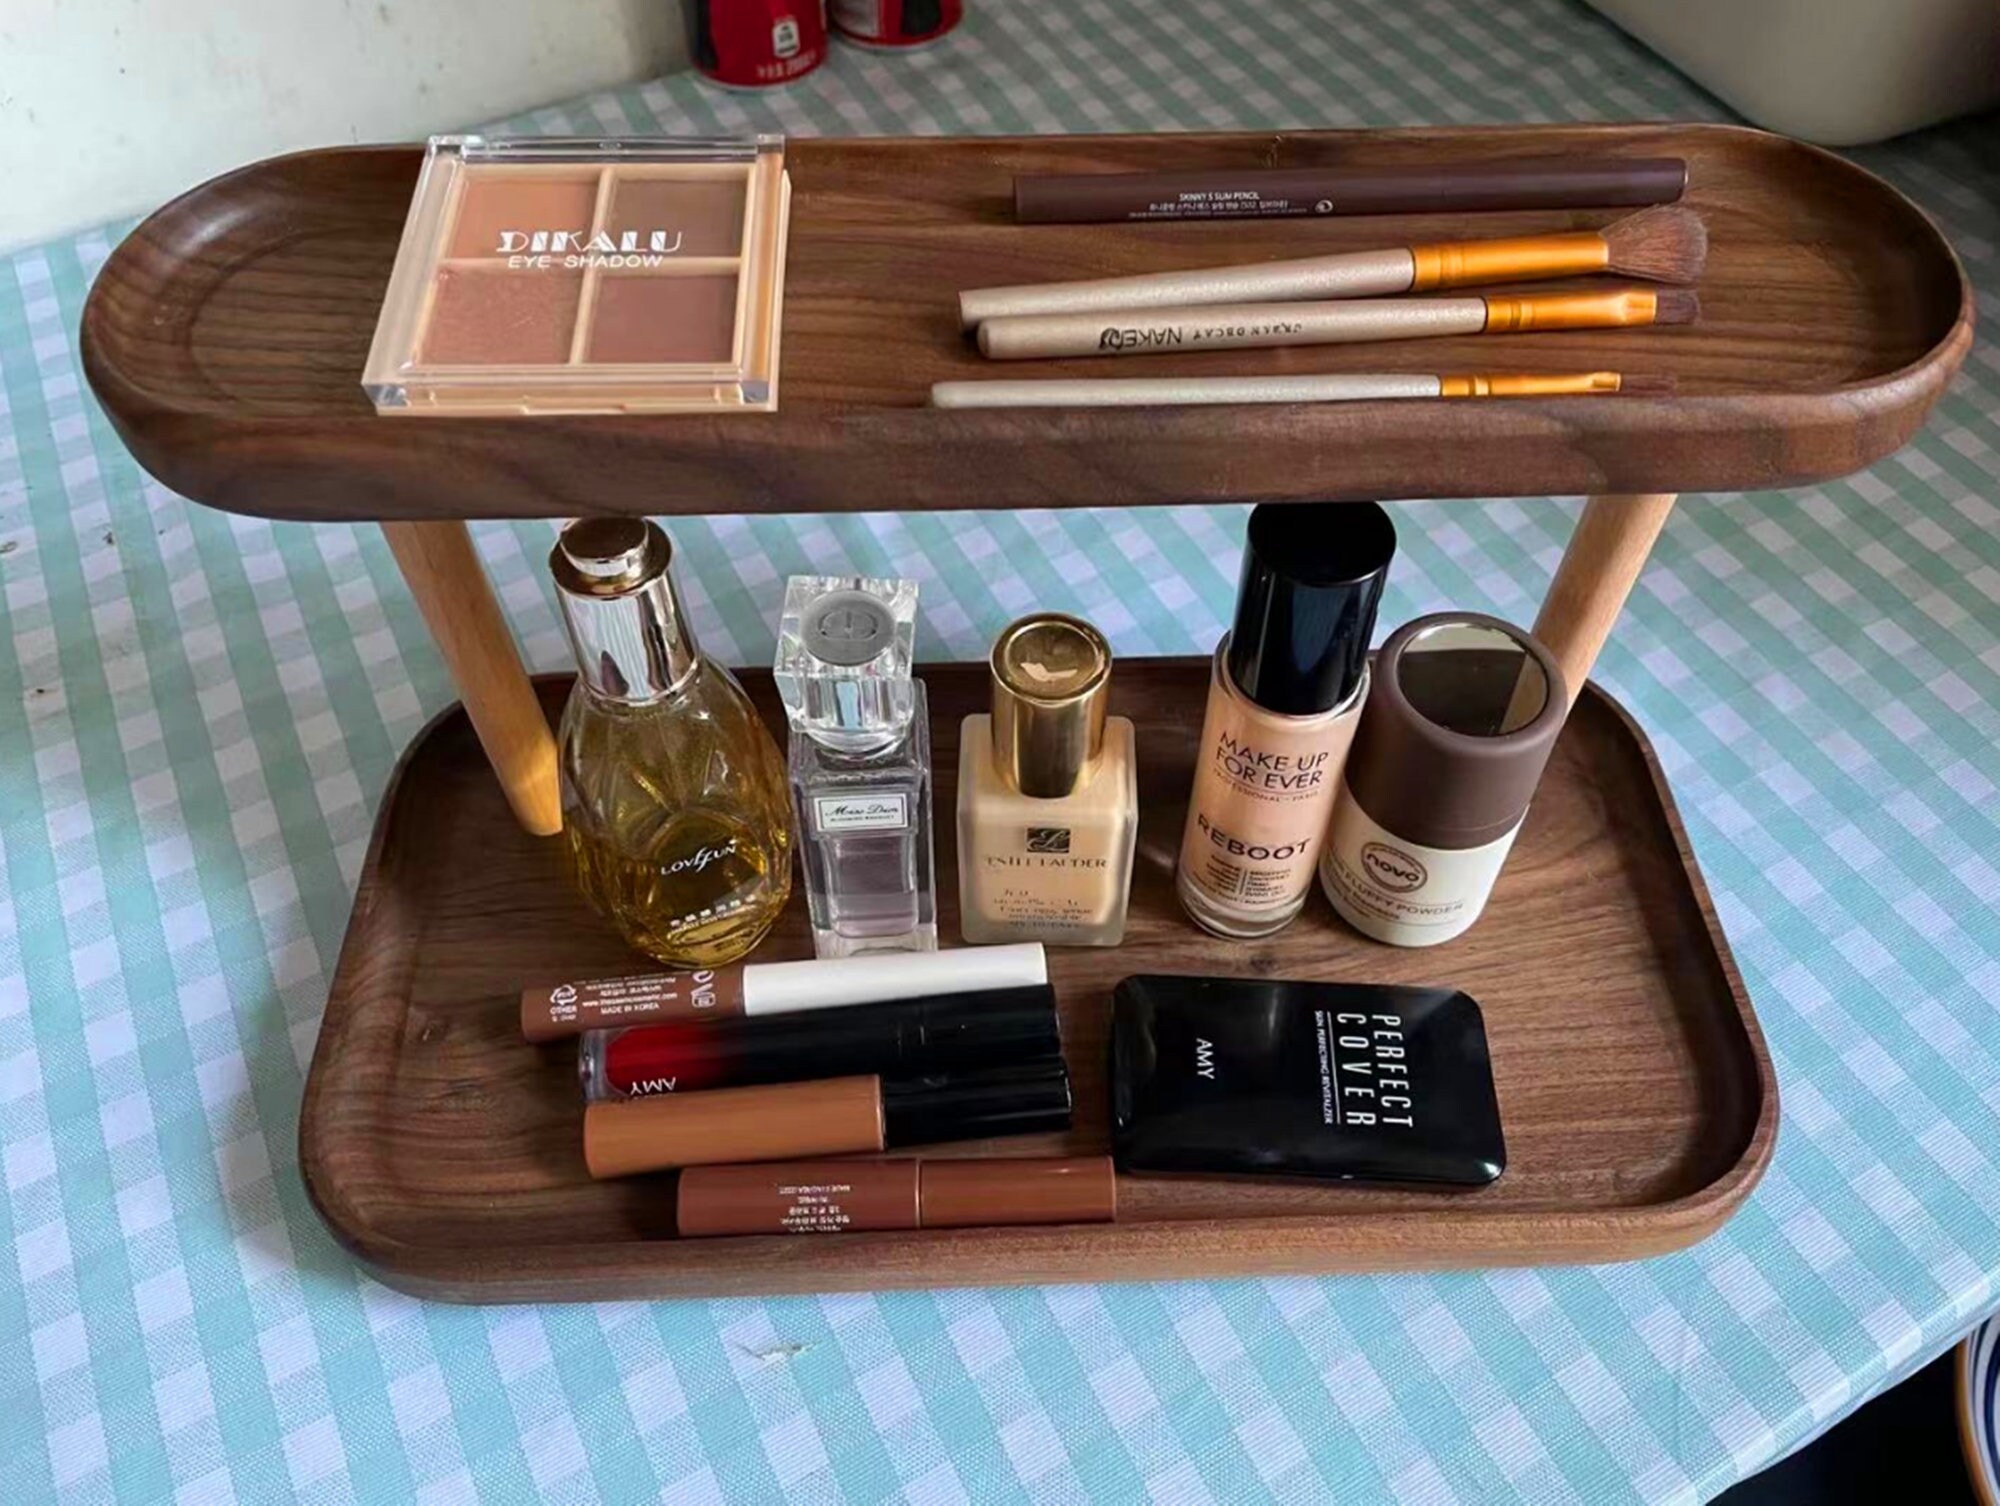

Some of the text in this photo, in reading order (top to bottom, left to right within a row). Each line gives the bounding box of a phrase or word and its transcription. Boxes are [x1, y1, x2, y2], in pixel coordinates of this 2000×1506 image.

[496, 230, 683, 252] DIKALU
[507, 254, 664, 269] EYE SHADOW
[1215, 745, 1323, 790] FOR EVER
[1219, 731, 1329, 773] MAKE UP
[1197, 813, 1311, 861] REBOOT
[1195, 1037, 1215, 1080] AMY
[1336, 1012, 1377, 1126] COVER
[1371, 1014, 1414, 1128] PERFECT
[630, 1076, 677, 1096] AMY
